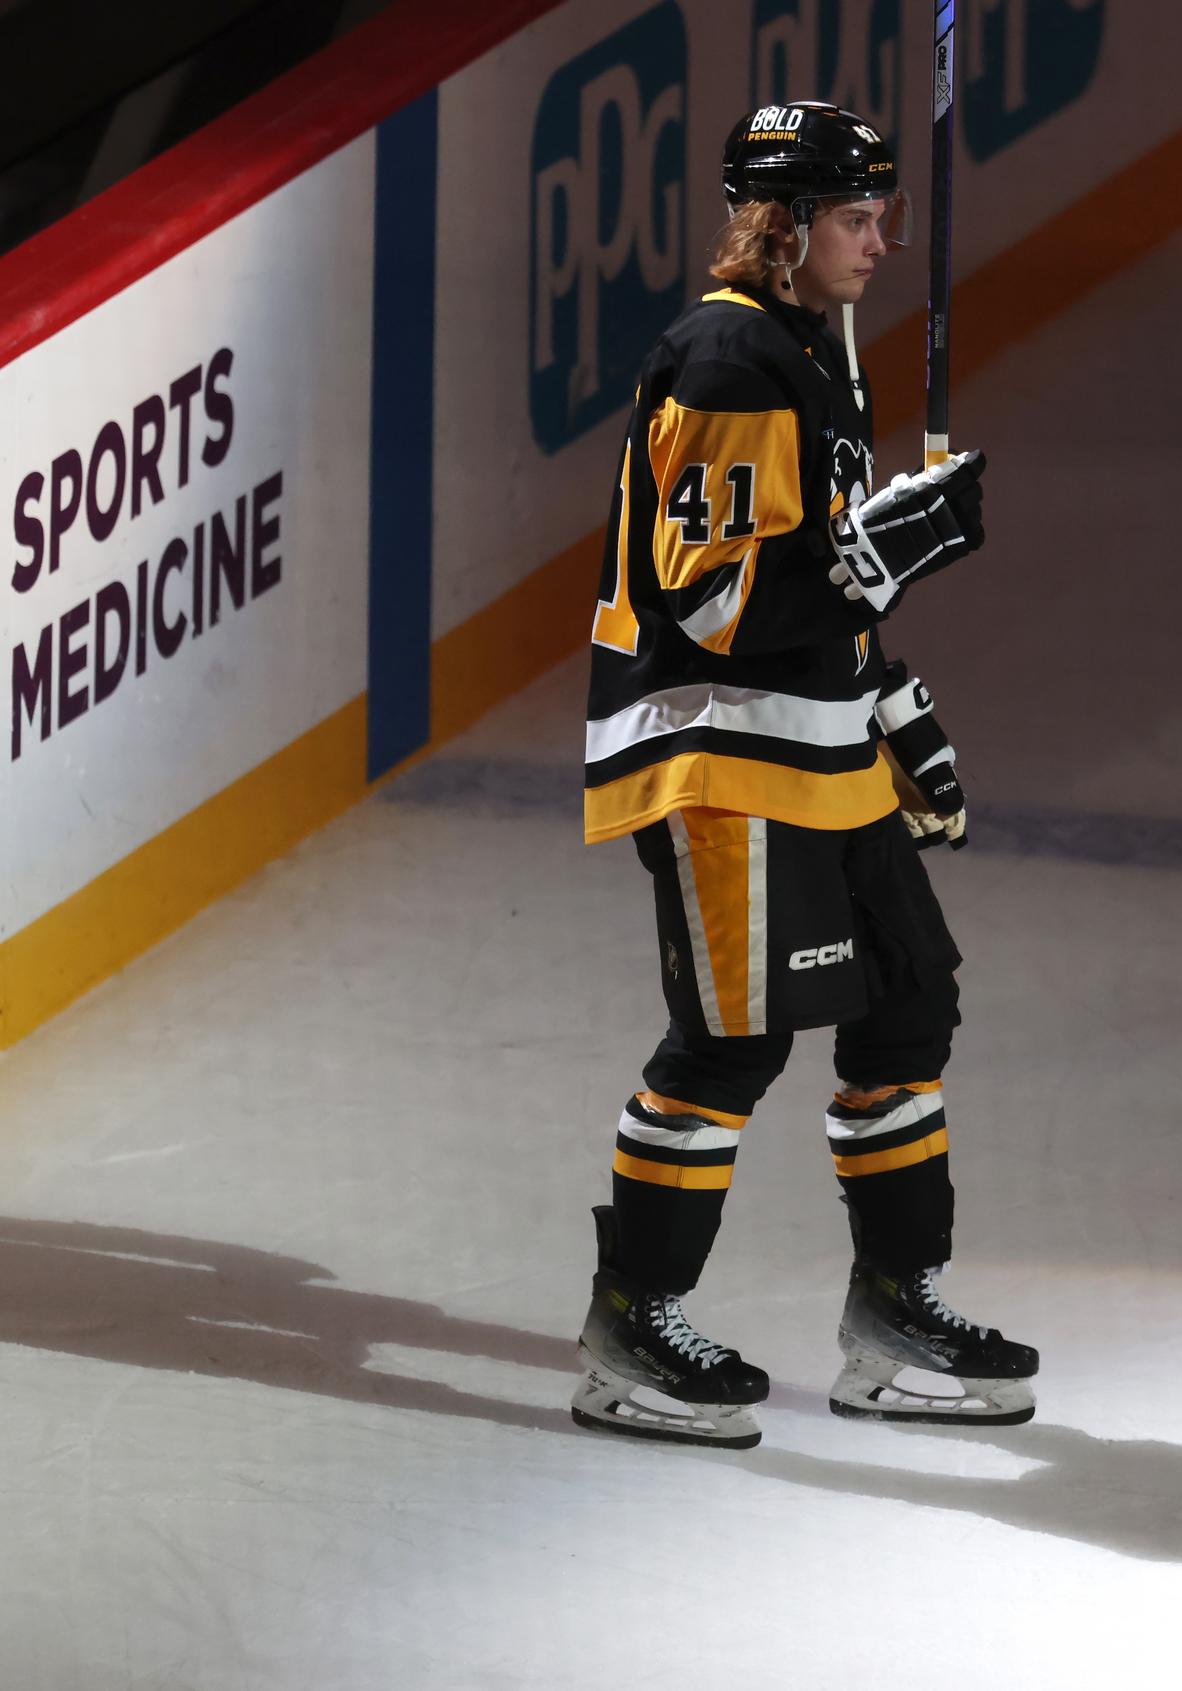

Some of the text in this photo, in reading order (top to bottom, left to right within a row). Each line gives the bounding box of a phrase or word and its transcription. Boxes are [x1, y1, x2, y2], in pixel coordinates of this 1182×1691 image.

[938, 45, 947, 71] PRO
[750, 107, 804, 132] BOLD
[748, 131, 797, 142] PENGUIN
[868, 162, 893, 173] CCM
[11, 347, 235, 594] SPORTS
[666, 462, 758, 545] 41
[11, 470, 284, 762] MEDICINE
[788, 938, 855, 971] CCM
